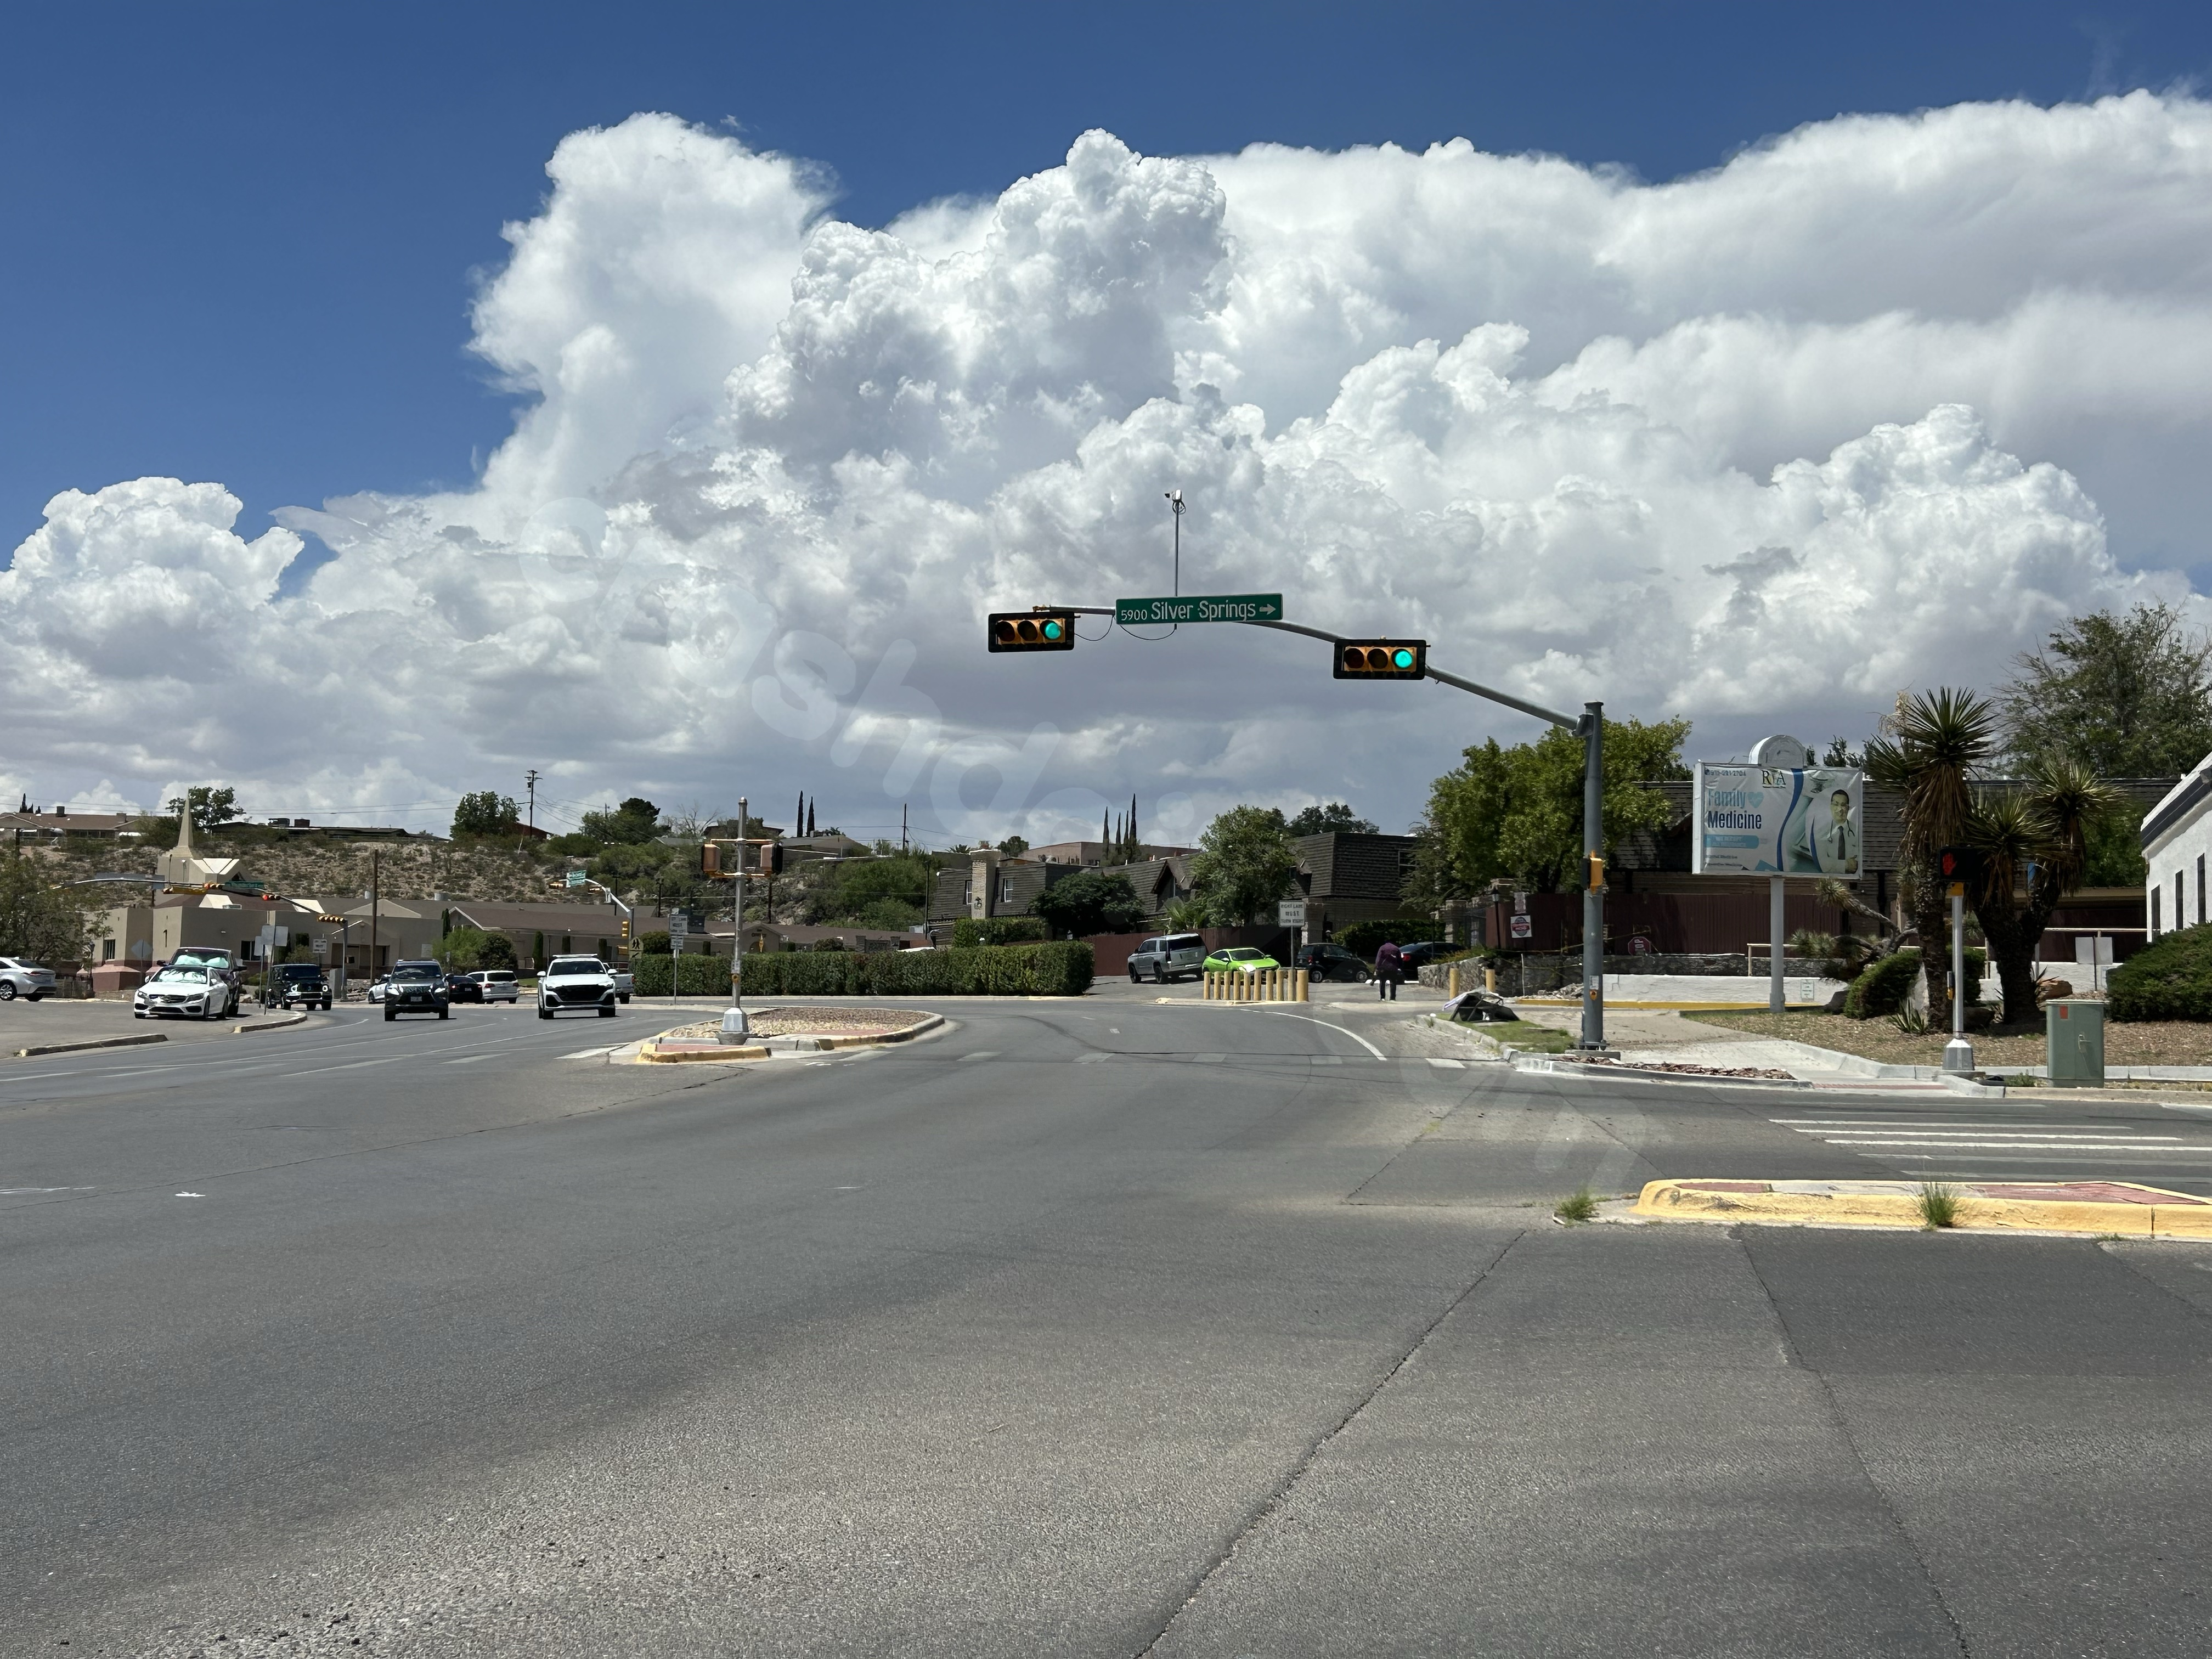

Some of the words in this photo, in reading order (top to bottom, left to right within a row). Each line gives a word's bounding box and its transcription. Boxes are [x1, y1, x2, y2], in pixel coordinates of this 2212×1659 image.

[1121, 610, 1147, 620] 5900
[1151, 601, 1194, 620] Silver
[1198, 600, 1256, 622] Springs
[1708, 788, 1746, 809] Family
[1707, 810, 1762, 829] Medicine
